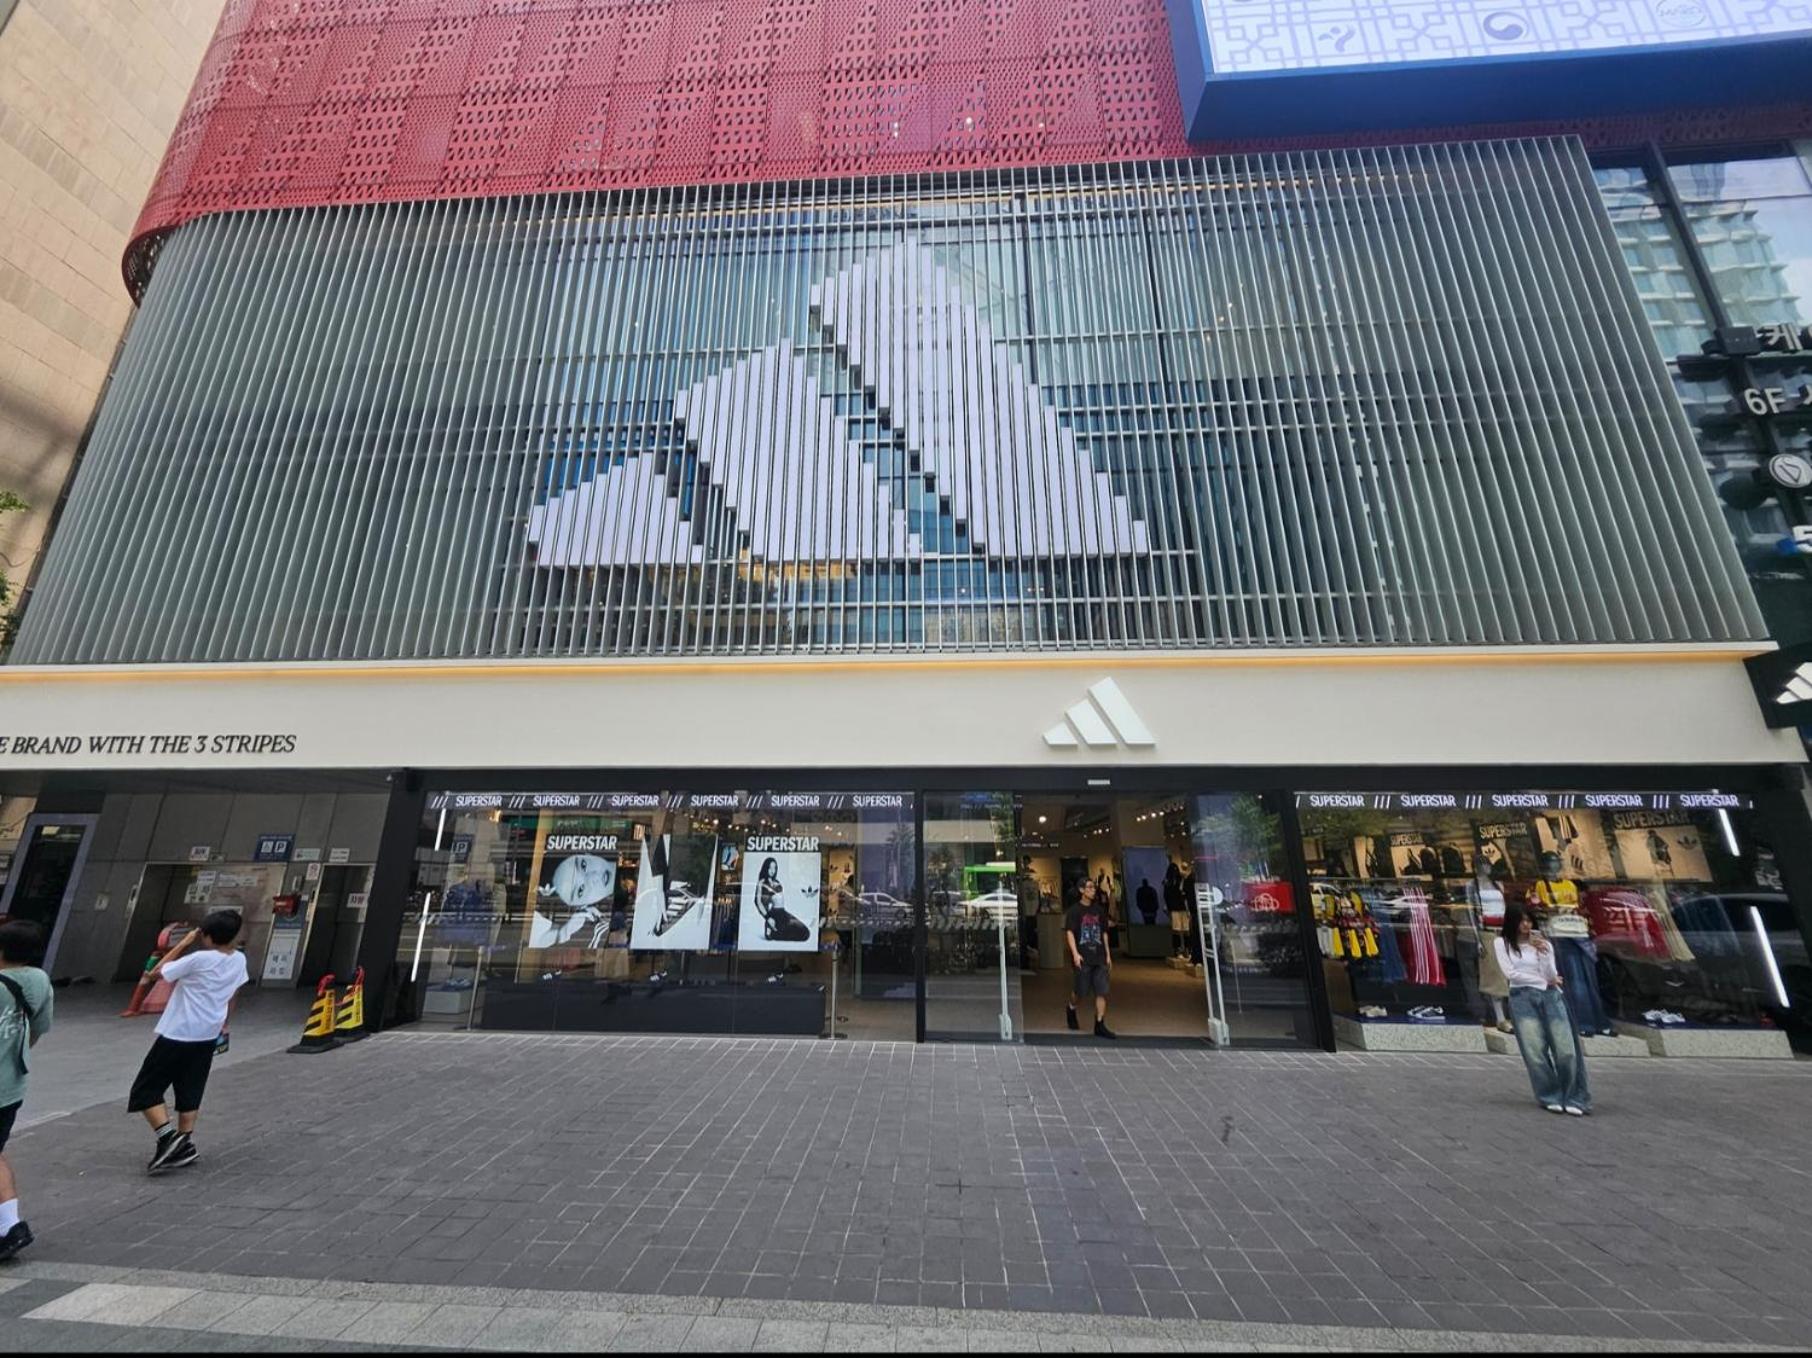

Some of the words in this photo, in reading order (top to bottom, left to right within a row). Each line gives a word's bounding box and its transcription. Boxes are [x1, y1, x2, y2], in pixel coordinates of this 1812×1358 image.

[1744, 387, 1786, 416] 6F
[11, 736, 81, 754] BRAND
[88, 735, 146, 753] WITH
[149, 735, 192, 753] THE
[194, 735, 207, 753] 3
[211, 734, 297, 753] STRIPES
[455, 795, 503, 807] SUPERSTAR
[532, 795, 580, 807] SUPERSTAR
[611, 795, 659, 807] SUPERSTAR
[691, 795, 739, 807] SUPERSTAR
[771, 795, 820, 807] SUPERSTAR
[853, 795, 903, 807] SUPERSTAR
[1310, 795, 1365, 807] SUPERSTAR
[1401, 795, 1456, 807] SUPERSTAR
[1492, 795, 1549, 807] SUPERSTAR
[1585, 794, 1643, 807] SUPERSTAR
[1680, 794, 1740, 807] SUPERSTAR
[1614, 811, 1689, 828] SUPERSTAR
[1479, 822, 1528, 839] SUPERSTAR
[547, 835, 618, 851] SUPERSTAR
[747, 836, 820, 851] SUPERSTAR
